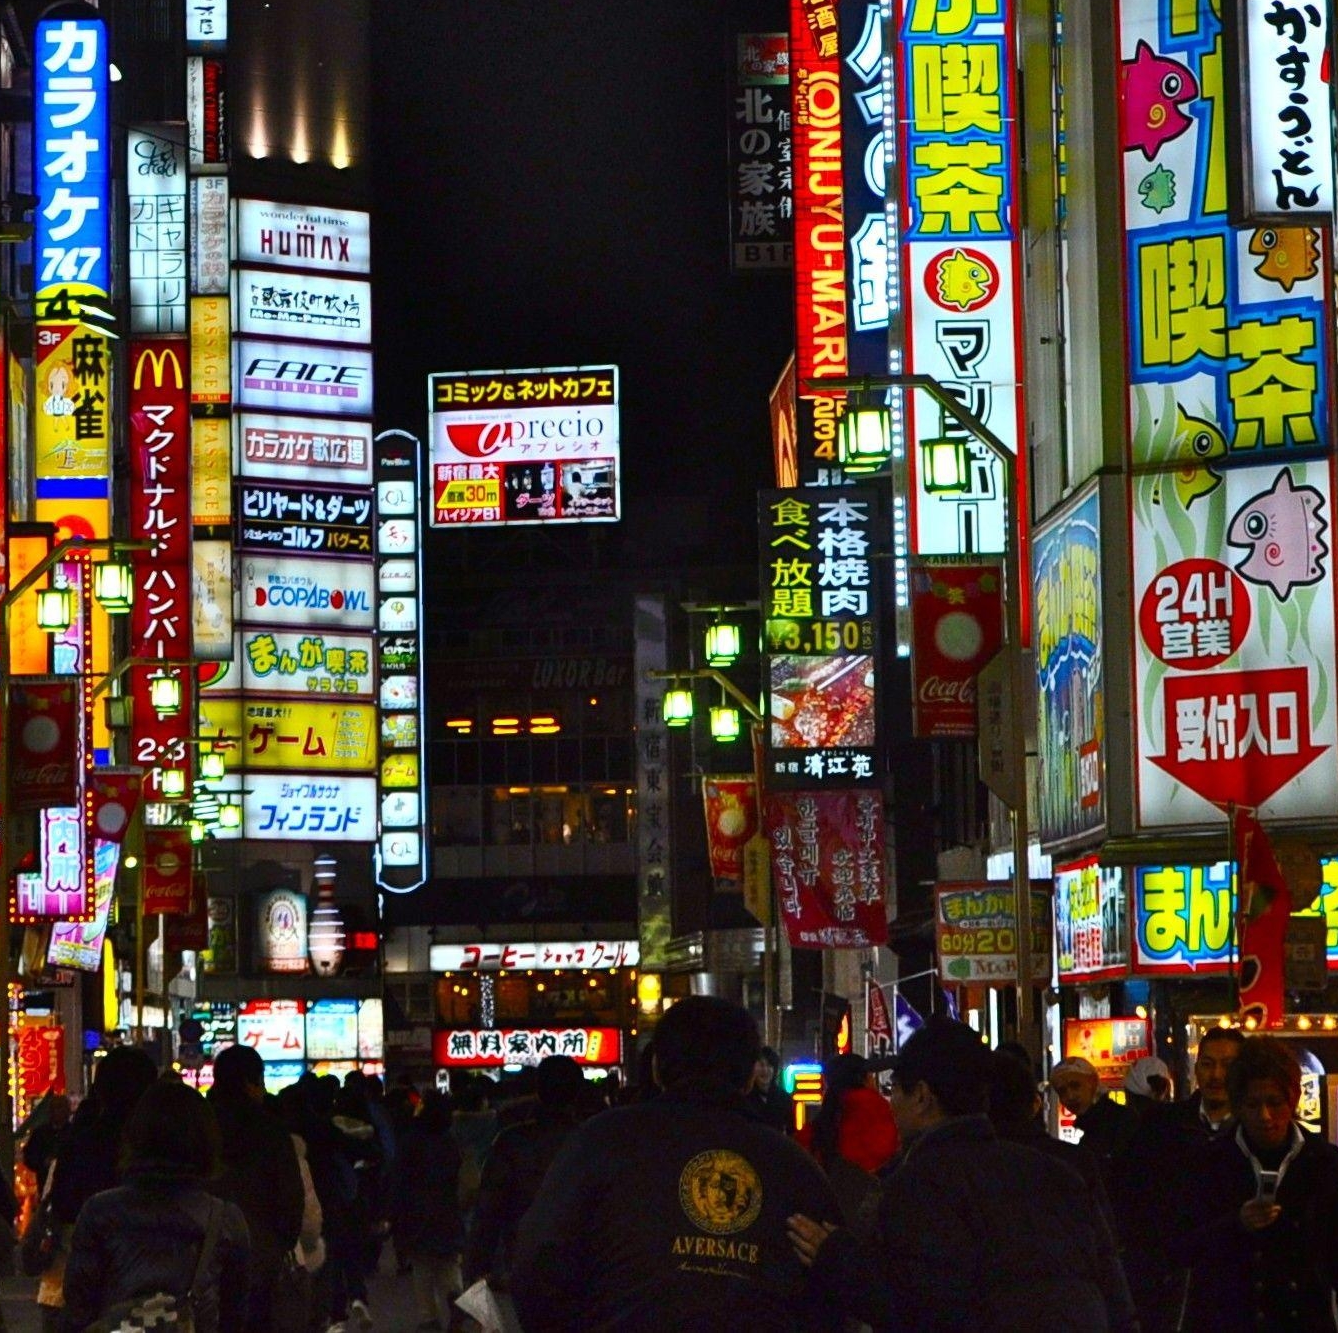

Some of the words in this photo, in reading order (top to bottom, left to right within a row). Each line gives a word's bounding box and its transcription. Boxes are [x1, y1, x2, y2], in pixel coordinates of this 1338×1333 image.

[1264, 0, 1321, 211] かすうどん
[43, 20, 100, 241] カラオケ
[736, 88, 775, 236] 北の家族
[205, 179, 224, 189] 3F
[260, 210, 320, 223] wonderful
[261, 224, 350, 262] HUMAX
[41, 247, 102, 282] 747
[159, 198, 184, 331] ギャラリー
[38, 330, 62, 345] 3F
[204, 300, 218, 388] PASSAGE
[71, 334, 106, 441] 麻雀
[245, 359, 367, 386] FACE
[437, 377, 612, 403] コミック&ネットカフェ
[520, 440, 601, 454] アプレシオ
[437, 464, 499, 481] 新宿最大
[243, 489, 371, 524] ビリヤード&ダーツ
[328, 533, 371, 551] バグース
[771, 498, 812, 618] 食べ放題
[818, 498, 870, 615] 本格焼肉
[1156, 571, 1234, 622] 24H
[247, 634, 369, 678] まんが喫茶
[1160, 620, 1231, 657] 営業
[249, 725, 327, 757] ゲーム
[1175, 693, 1298, 761] 受付入口
[775, 762, 798, 773] 新宿
[259, 804, 362, 832] フィンランド
[461, 944, 535, 968] コーヒー
[244, 1030, 302, 1050] ゲーム
[448, 1032, 586, 1058] 無料案内所
